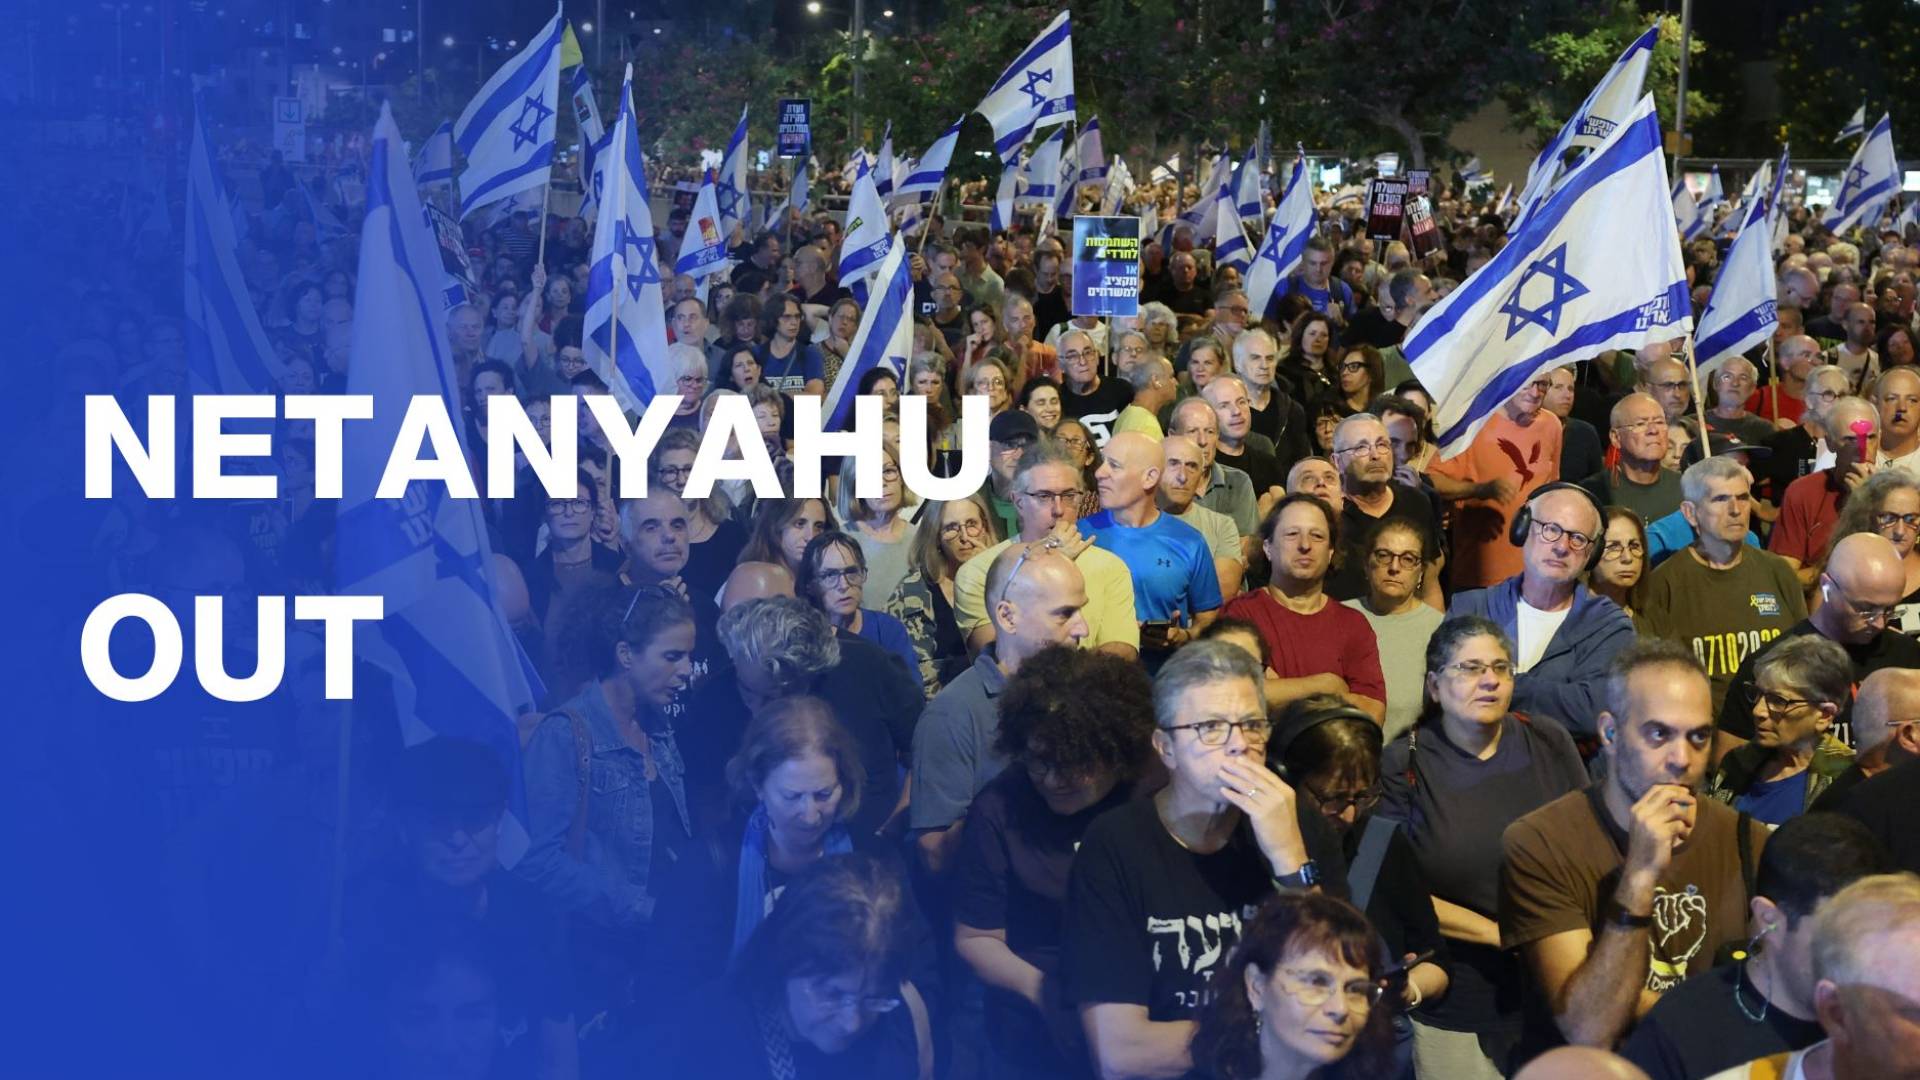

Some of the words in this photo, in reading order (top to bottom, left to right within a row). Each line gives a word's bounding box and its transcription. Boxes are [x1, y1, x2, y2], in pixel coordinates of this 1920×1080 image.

[1374, 181, 1408, 194] ממשלת
[1085, 236, 1139, 248] השתמטות
[1125, 265, 1138, 275] או
[1104, 275, 1137, 288] תקציב
[1087, 286, 1137, 298] למשרתים
